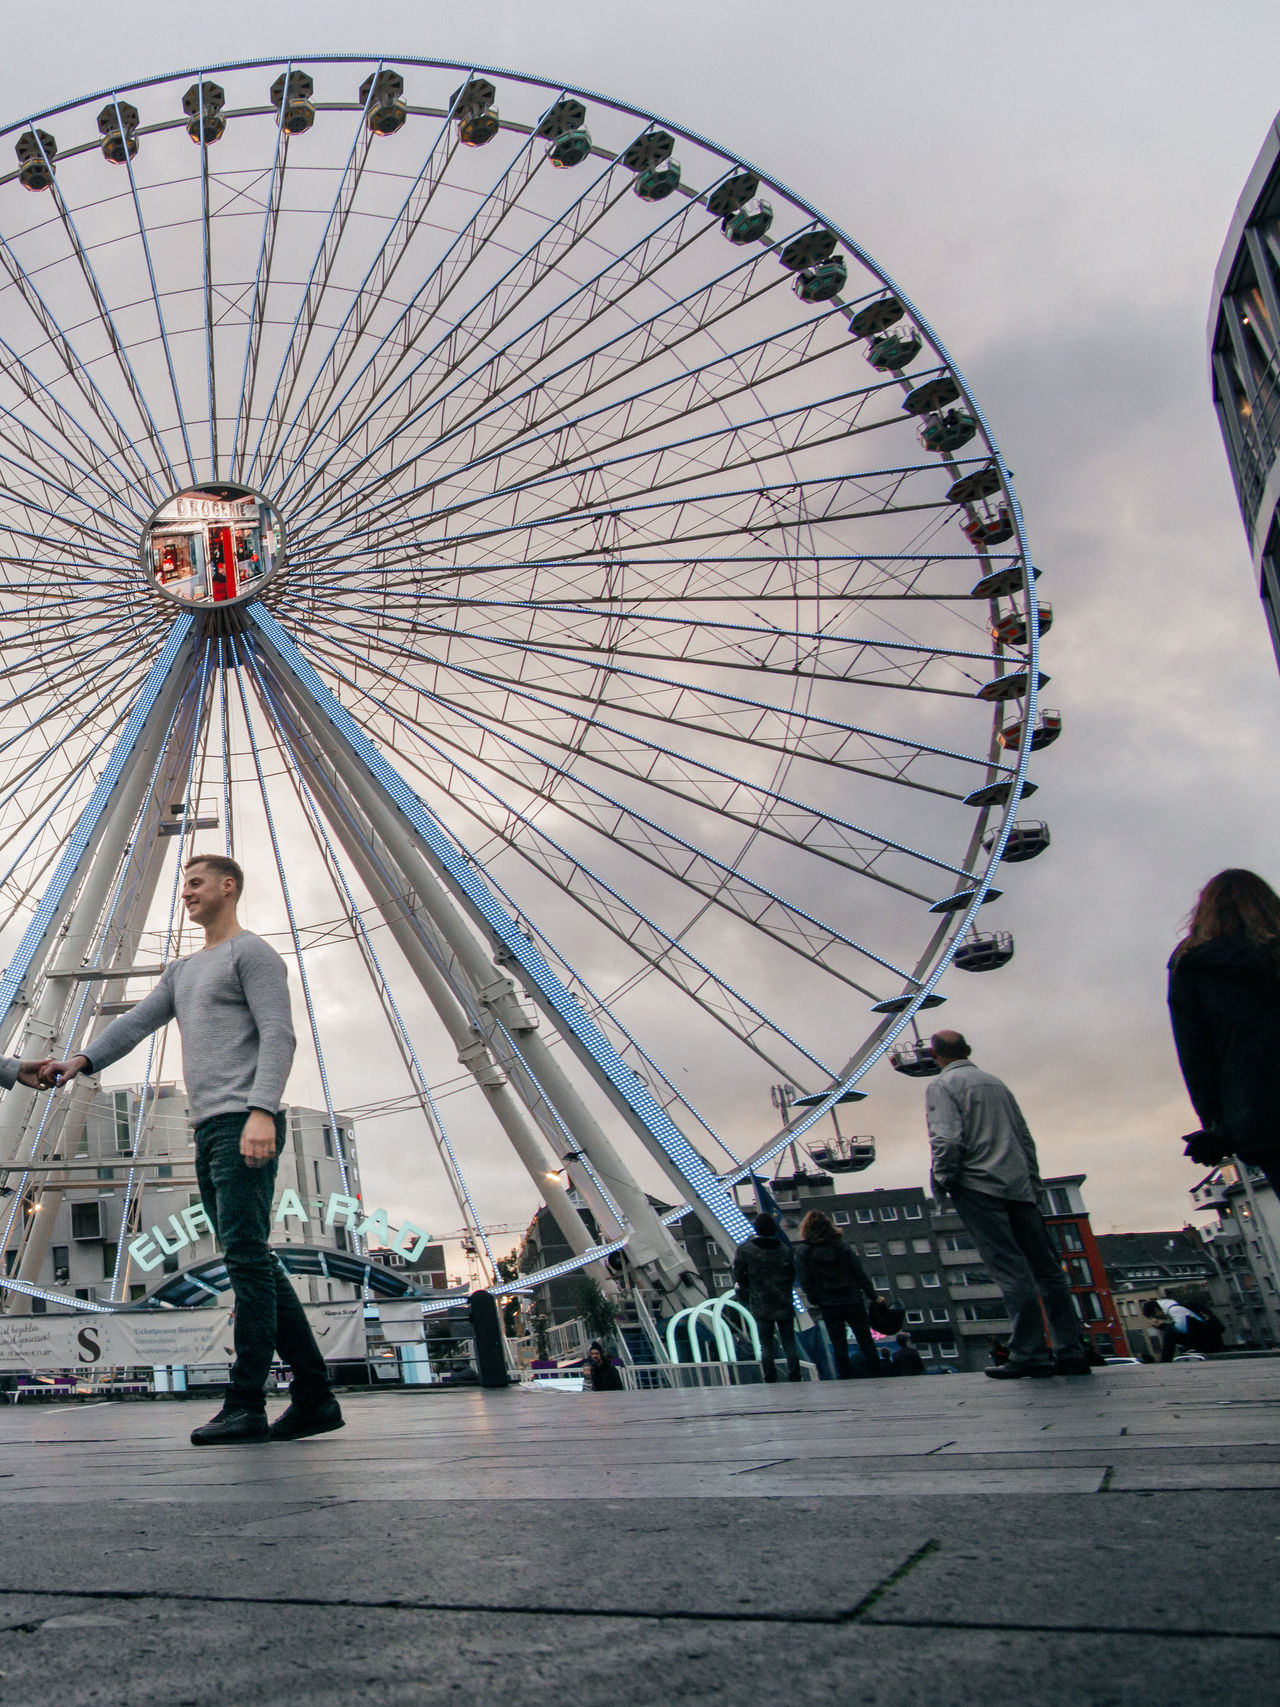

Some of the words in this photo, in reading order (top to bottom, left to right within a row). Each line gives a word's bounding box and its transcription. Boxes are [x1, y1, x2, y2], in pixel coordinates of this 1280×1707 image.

[177, 499, 246, 517] DROGERIE
[134, 1327, 177, 1336] Ticketpreise
[178, 1326, 214, 1334] Riesenrad
[78, 1327, 101, 1363] S
